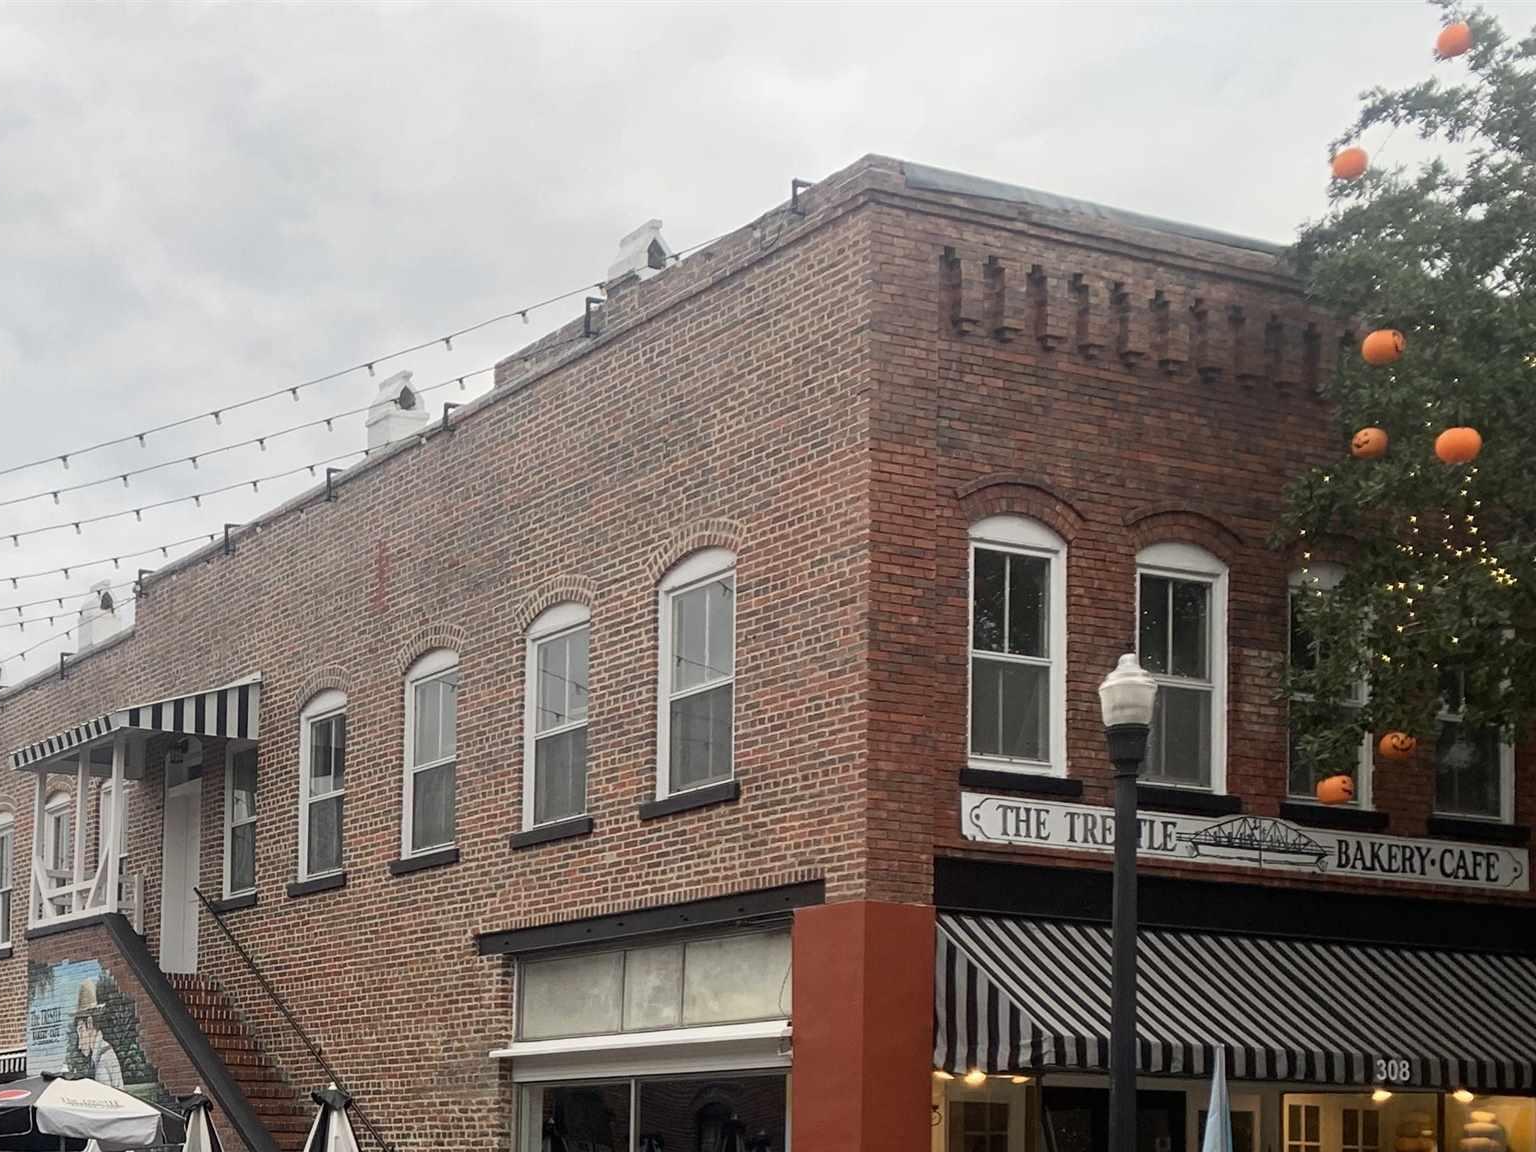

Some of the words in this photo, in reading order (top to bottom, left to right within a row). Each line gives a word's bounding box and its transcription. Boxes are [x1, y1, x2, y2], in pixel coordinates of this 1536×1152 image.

[996, 804, 1051, 841] THE
[1064, 811, 1178, 851] TRETLE
[1336, 839, 1431, 876] BAKERY
[1439, 849, 1499, 882] CAFE
[1376, 1059, 1410, 1080] 308
